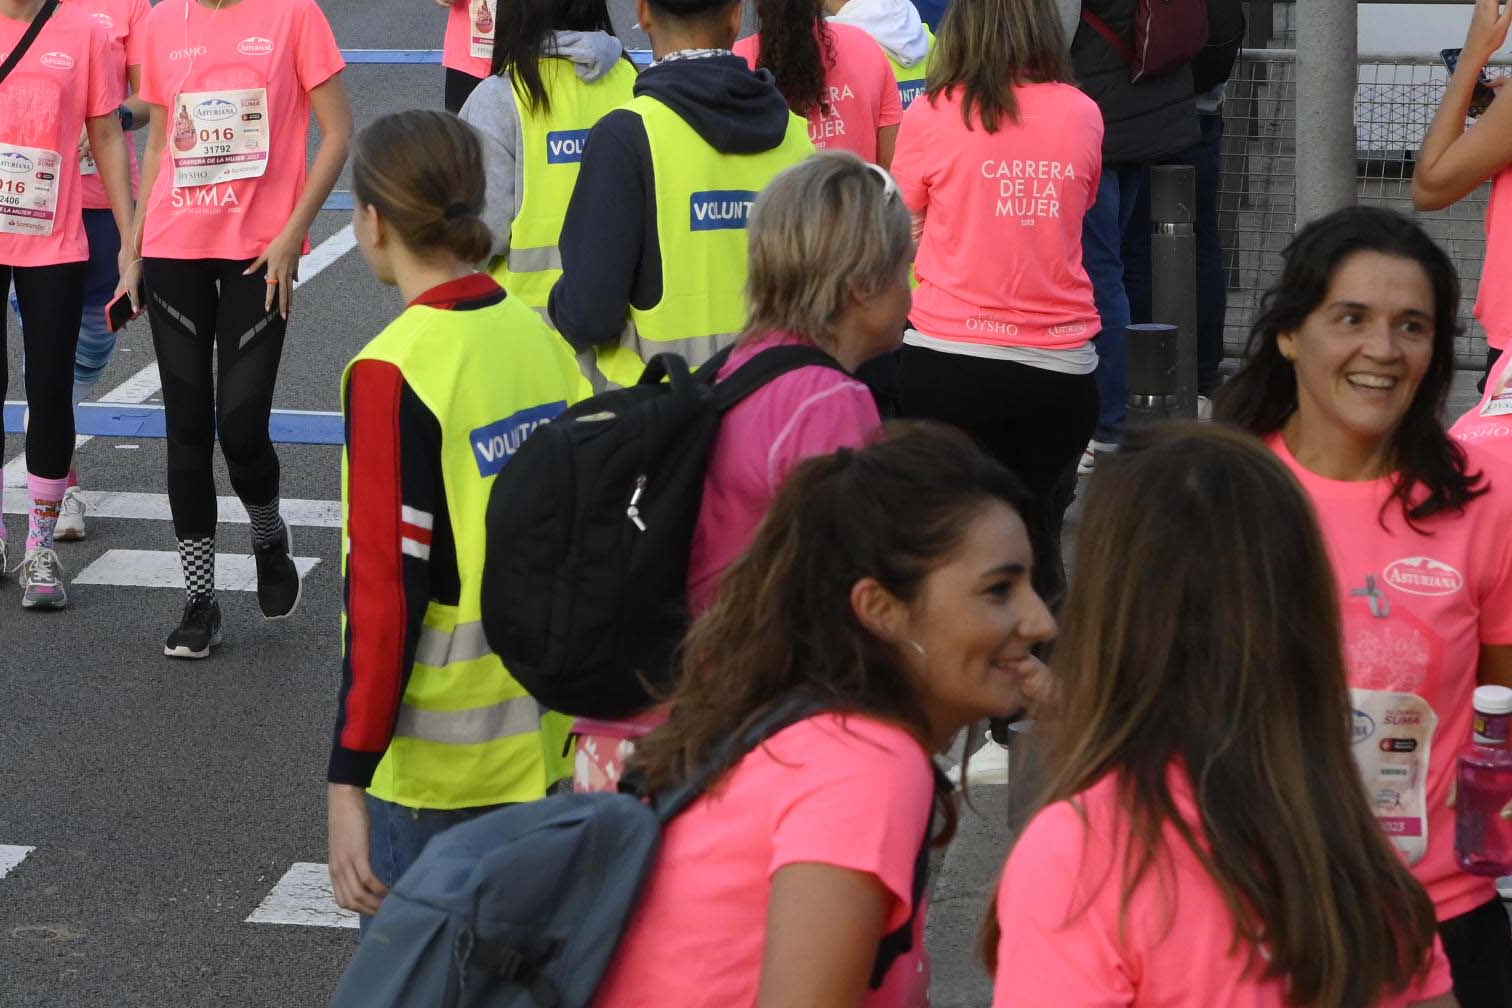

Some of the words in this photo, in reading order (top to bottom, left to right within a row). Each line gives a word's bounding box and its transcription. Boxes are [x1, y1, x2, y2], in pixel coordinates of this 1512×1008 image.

[196, 106, 234, 117] ASTURIANA
[200, 128, 234, 141] 016
[808, 120, 845, 141] UJER
[205, 145, 231, 154] 31792
[982, 160, 1075, 180] CARRERA
[1000, 180, 1024, 197] DE
[1033, 181, 1056, 198] LA
[694, 201, 754, 220] VOLUNT
[996, 199, 1059, 217] MUJER
[966, 318, 1018, 336] OYSHO
[1391, 568, 1457, 588] ASTURIANA
[1384, 822, 1405, 832] 023
